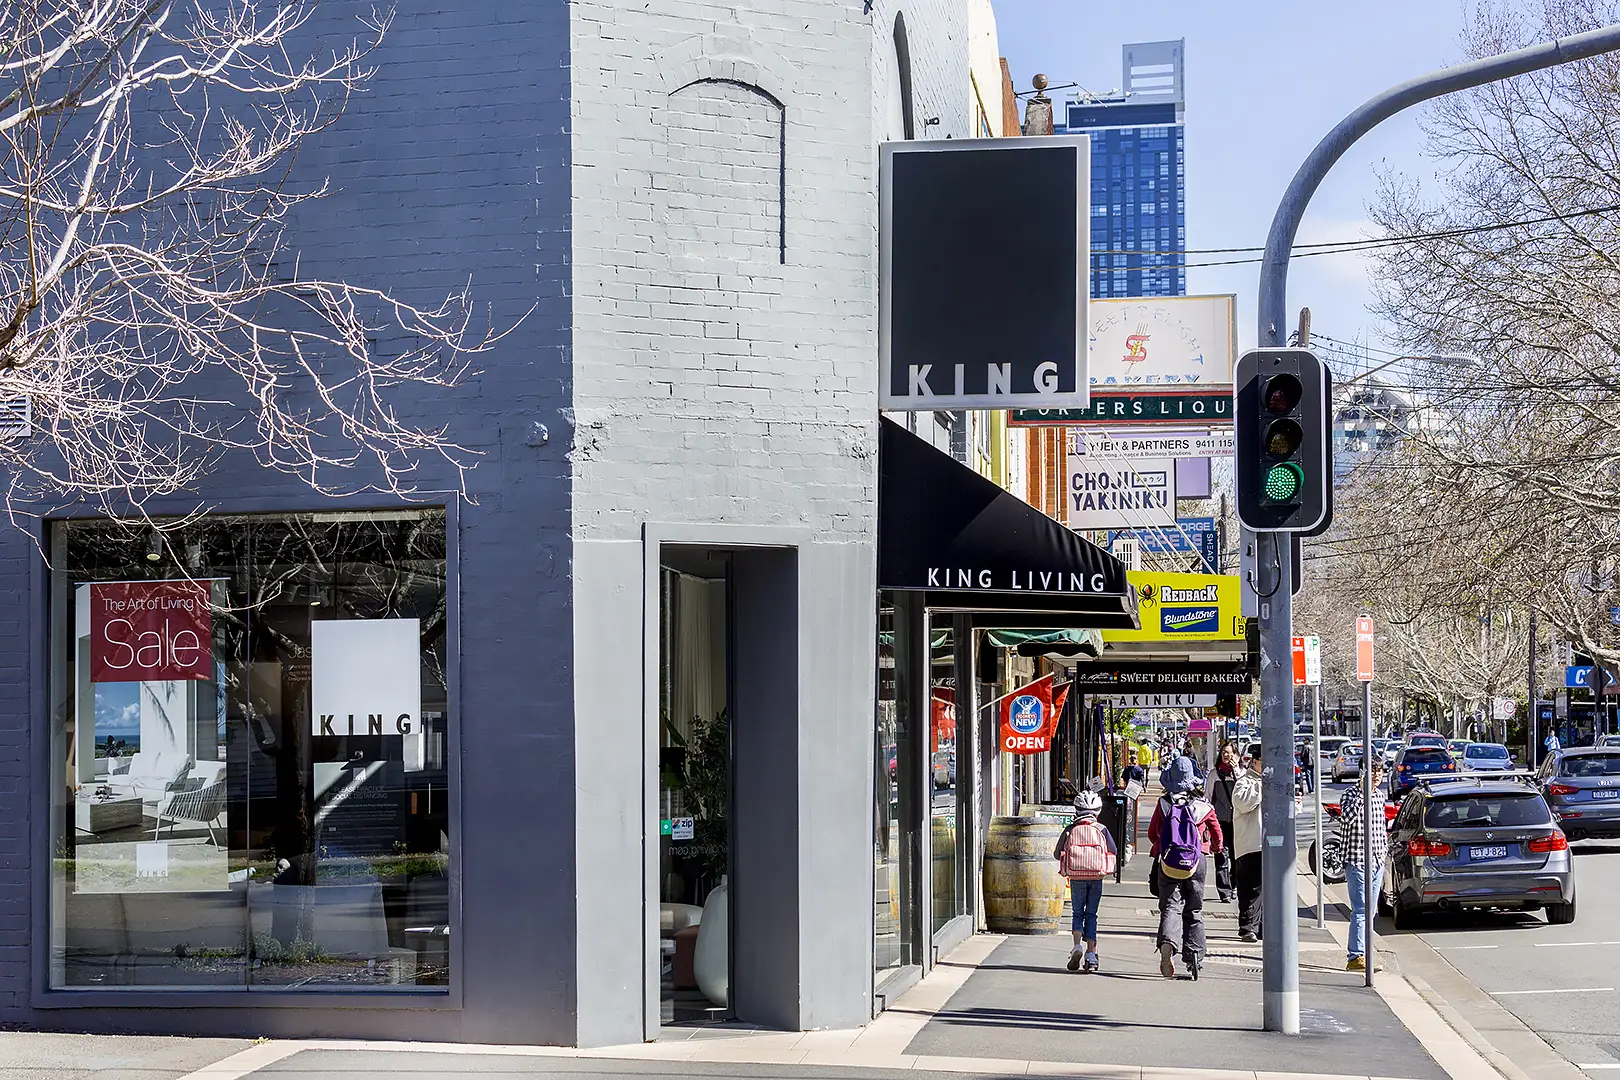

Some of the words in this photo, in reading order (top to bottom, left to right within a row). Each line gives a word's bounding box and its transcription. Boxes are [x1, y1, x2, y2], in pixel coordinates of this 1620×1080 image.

[908, 361, 1059, 396] KING
[1161, 401, 1225, 414] LIQU
[1122, 441, 1129, 450] &
[1132, 439, 1189, 450] PARTNERS
[1195, 440, 1215, 449] 9411
[1072, 471, 1129, 490] CHOJI
[1072, 490, 1167, 511] YAKINIKU
[928, 568, 992, 588] KING
[1012, 570, 1104, 592] LIVING
[103, 598, 125, 610] The
[127, 598, 145, 610] Art
[147, 597, 159, 610] of
[161, 597, 194, 611] Living
[103, 618, 200, 669] Sale
[1120, 672, 1155, 683] SWEET
[1158, 672, 1201, 683] DELIGHT
[1204, 672, 1248, 683] BAKERY
[1119, 694, 1195, 706] AKINIKU
[320, 713, 412, 735] KING
[1015, 718, 1037, 727] NEW
[1005, 736, 1045, 749] OPEN
[681, 818, 693, 828] zip
[138, 870, 166, 878] KING
